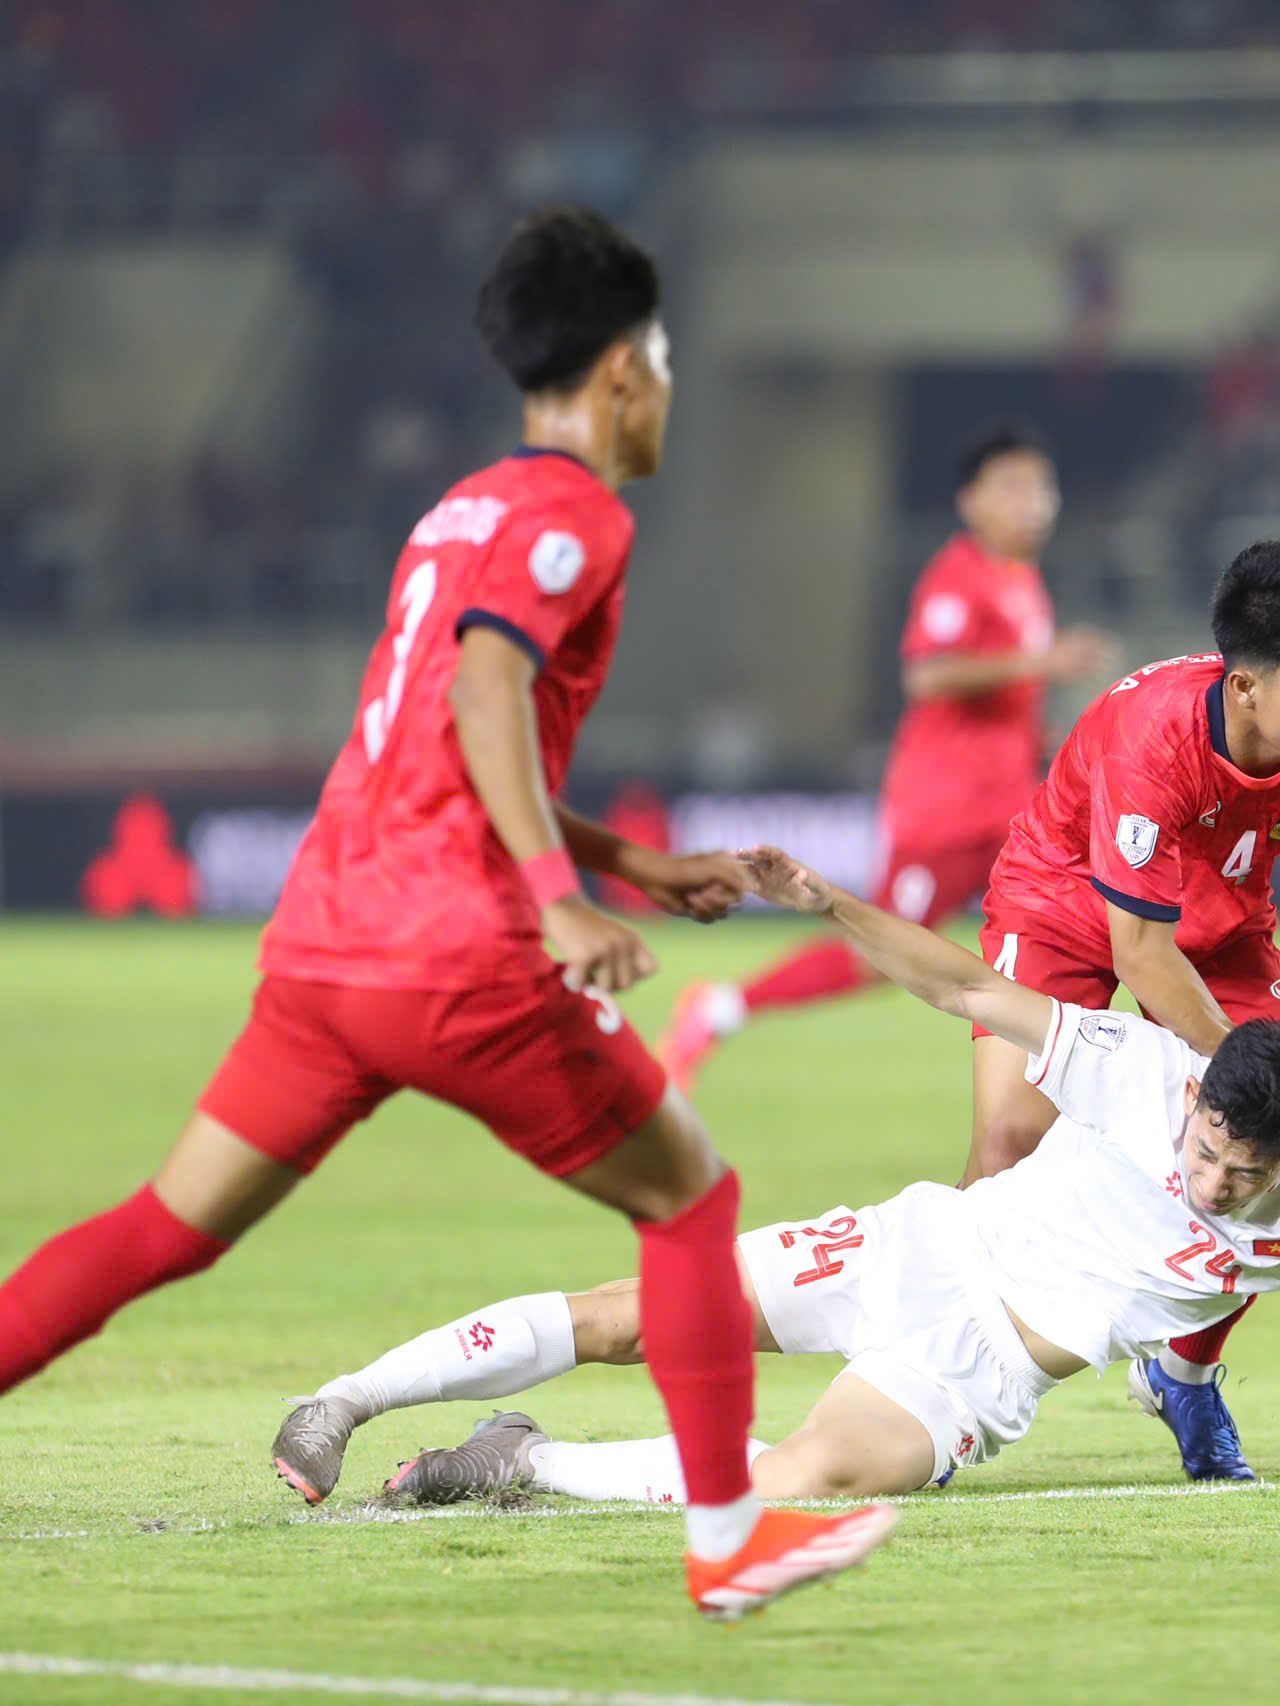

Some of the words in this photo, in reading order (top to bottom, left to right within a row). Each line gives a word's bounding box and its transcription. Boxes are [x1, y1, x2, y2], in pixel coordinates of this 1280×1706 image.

[363, 560, 437, 766] 3
[1221, 830, 1257, 887] 4
[778, 1215, 865, 1287] 24
[1164, 1220, 1243, 1294] 24
